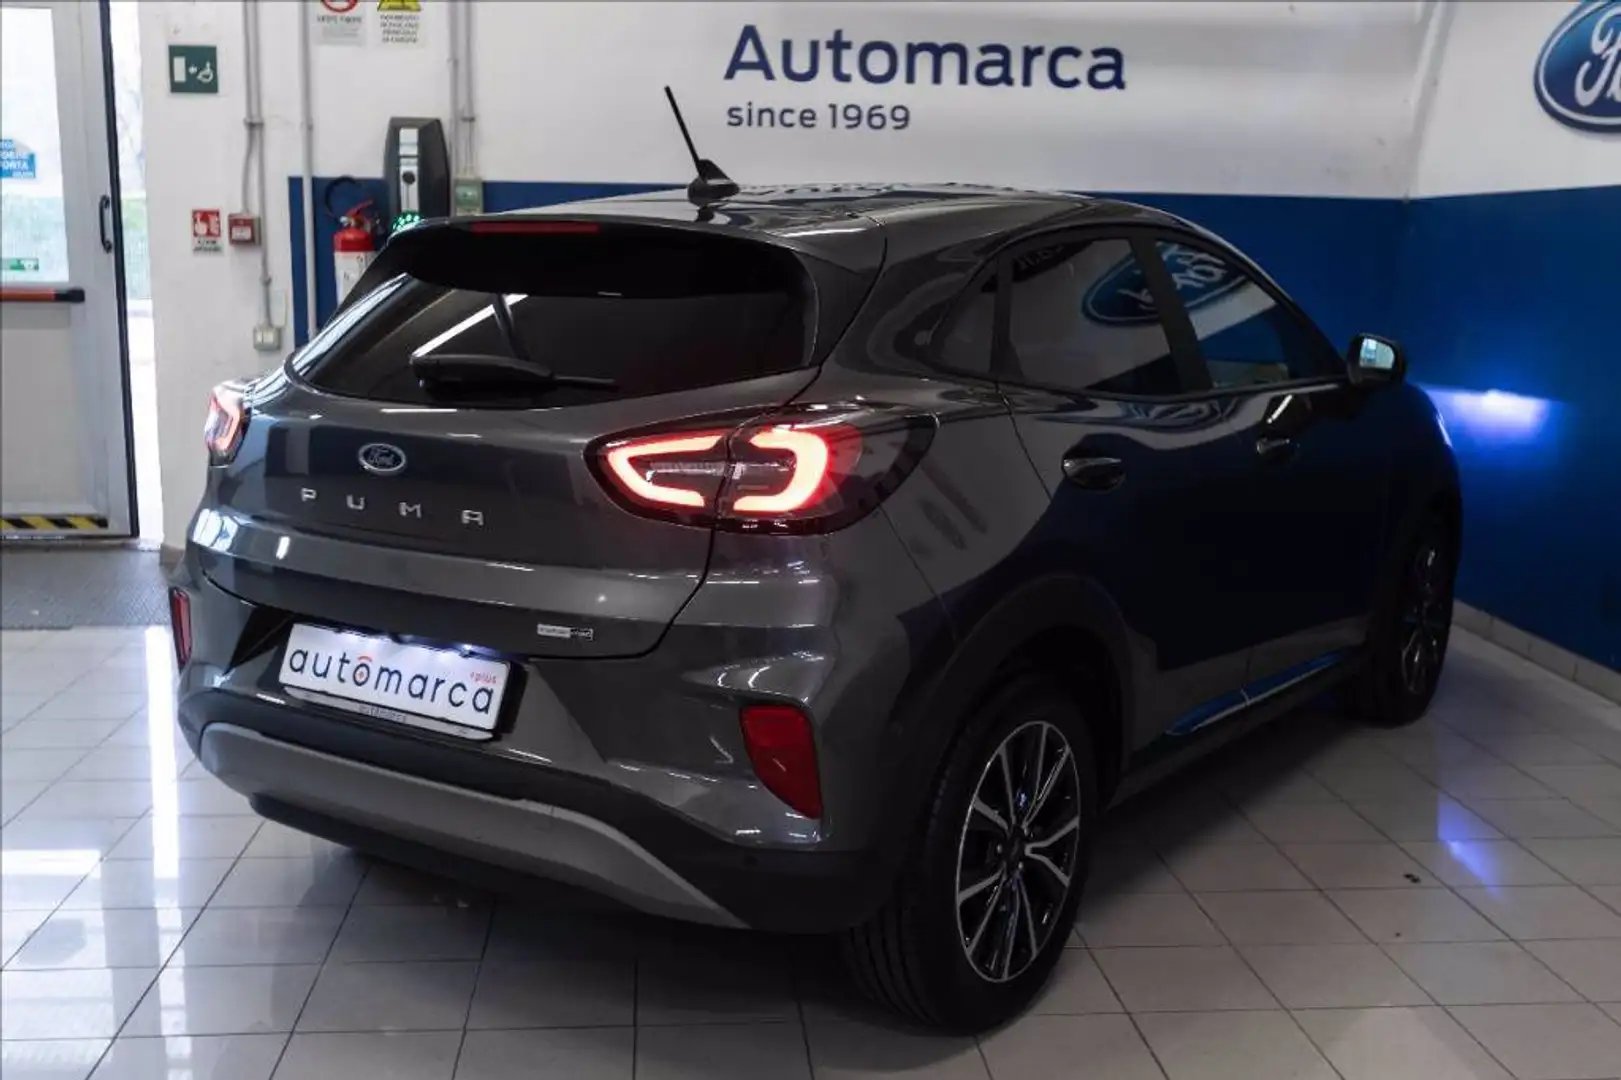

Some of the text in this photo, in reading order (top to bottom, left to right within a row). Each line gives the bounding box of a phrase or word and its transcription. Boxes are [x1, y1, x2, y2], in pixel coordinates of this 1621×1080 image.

[724, 24, 1126, 90] Automarca
[727, 102, 910, 130] since 1969
[301, 487, 484, 526] PUMA
[288, 648, 494, 715] automarca
